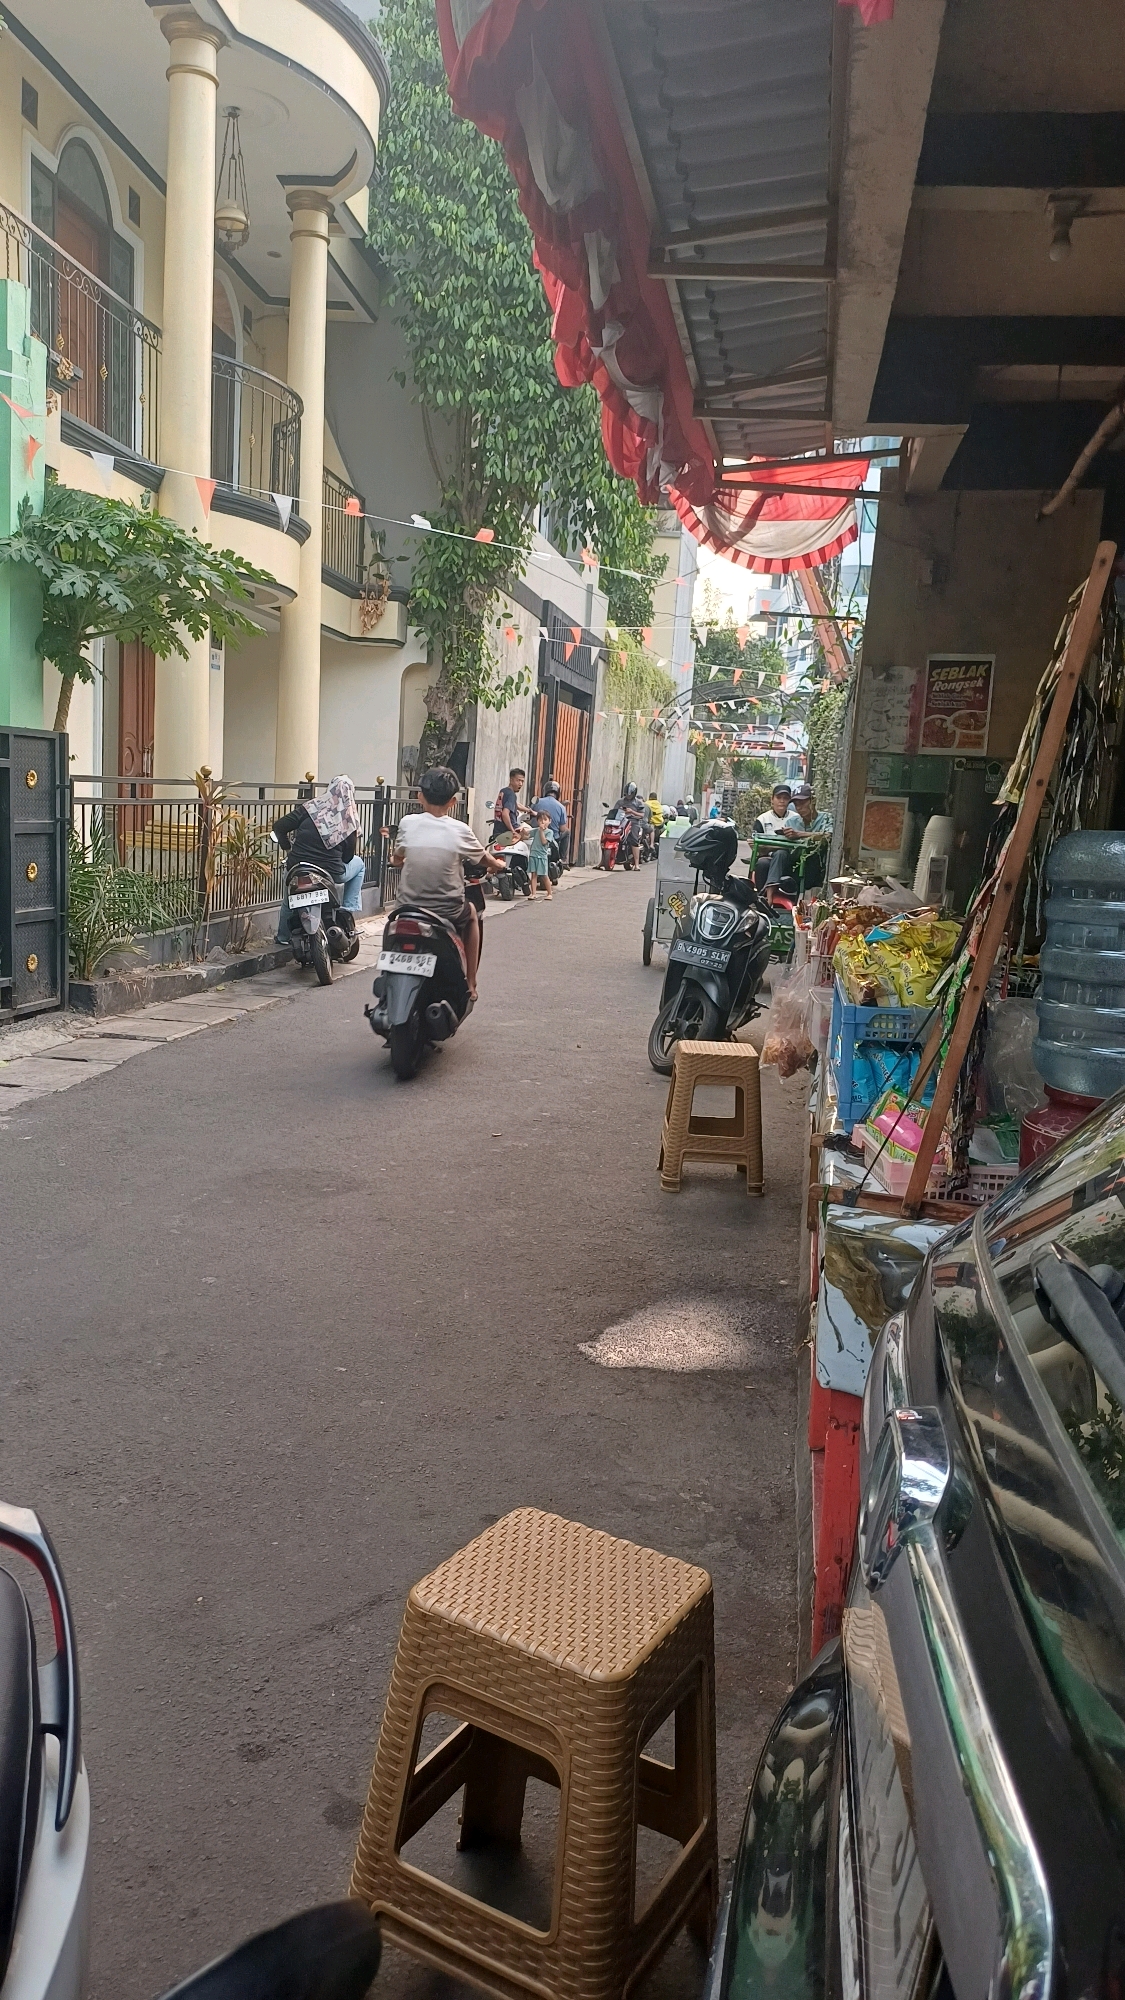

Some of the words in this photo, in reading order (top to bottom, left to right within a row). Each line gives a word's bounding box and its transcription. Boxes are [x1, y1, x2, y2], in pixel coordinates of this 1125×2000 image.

[930, 664, 989, 682] SEBLAK
[932, 677, 984, 692] Rongsek
[677, 943, 683, 951] B
[686, 945, 708, 957] 4905
